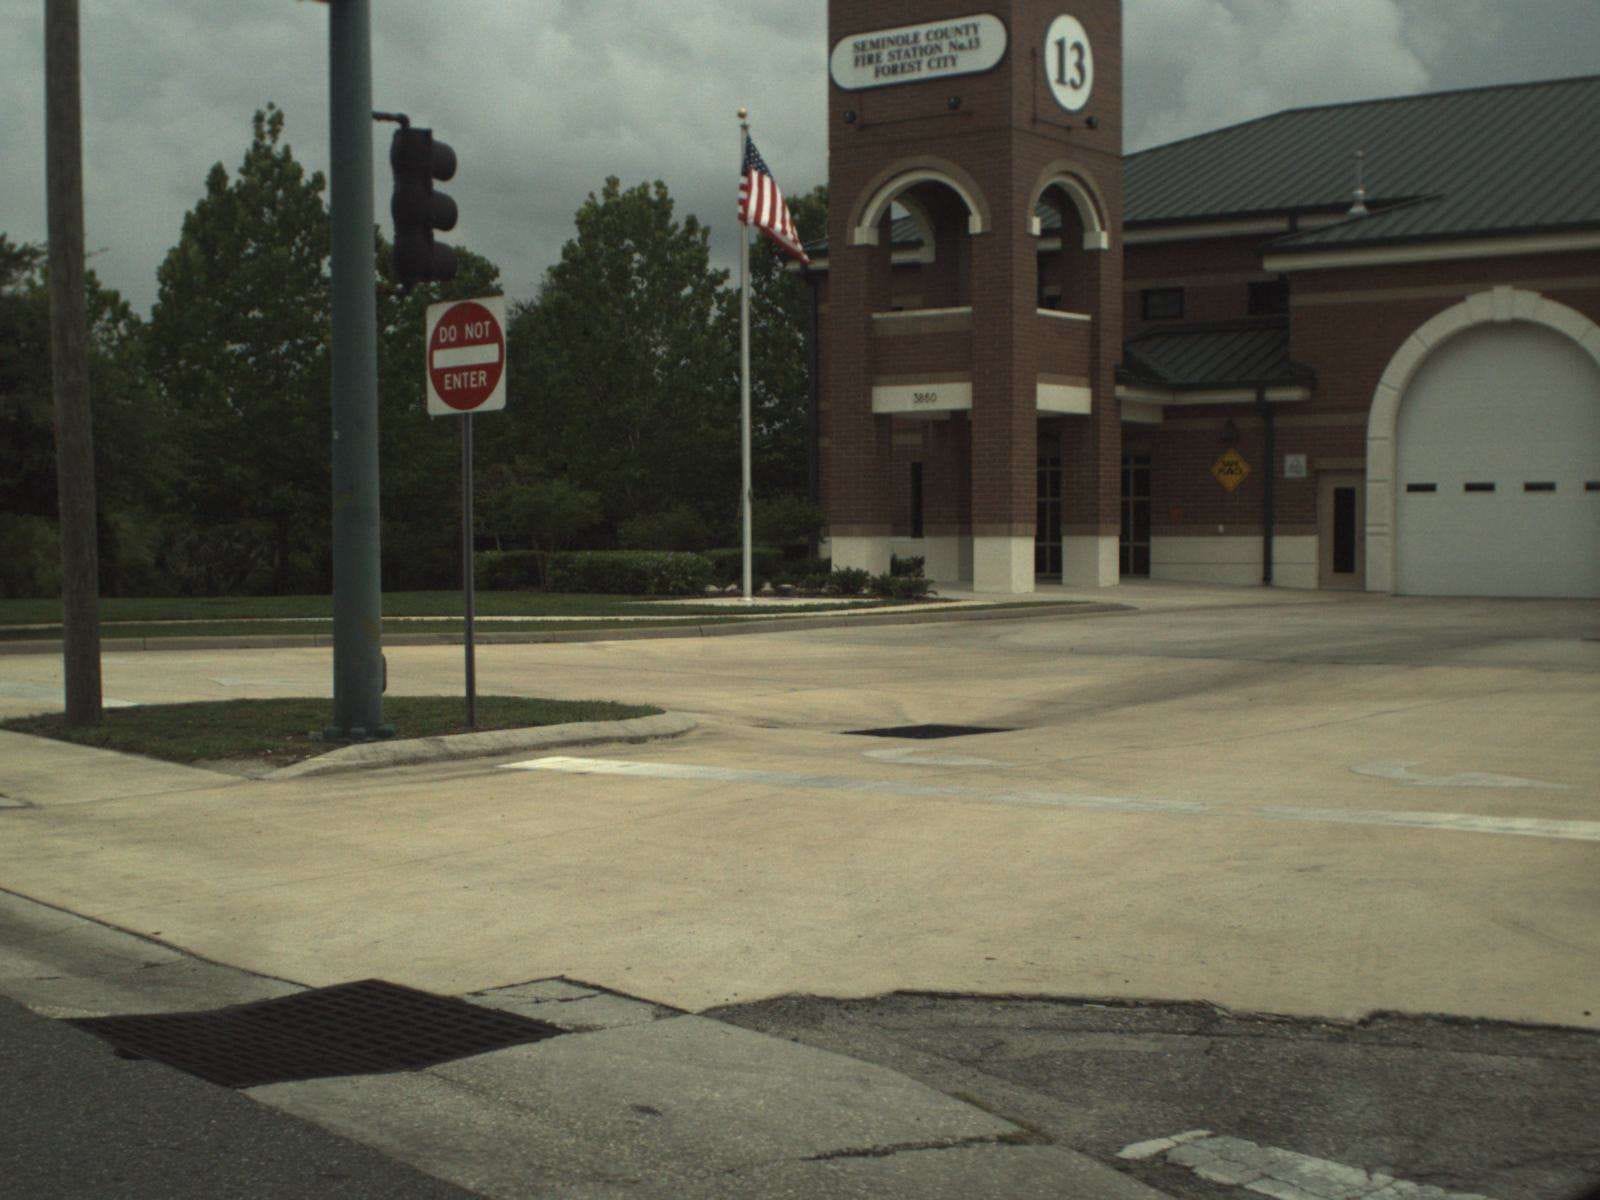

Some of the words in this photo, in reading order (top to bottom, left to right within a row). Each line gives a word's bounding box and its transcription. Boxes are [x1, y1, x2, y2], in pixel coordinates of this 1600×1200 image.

[852, 31, 920, 53] SEMINOLE
[926, 22, 980, 42] COUNTY
[854, 52, 882, 68] FIRE
[887, 44, 943, 62] STATION
[874, 60, 922, 78] FOREST
[927, 54, 958, 70] CITY
[1055, 37, 1086, 91] 13
[439, 325, 457, 343] DO
[464, 321, 491, 340] NOT
[444, 370, 487, 390] ENTER
